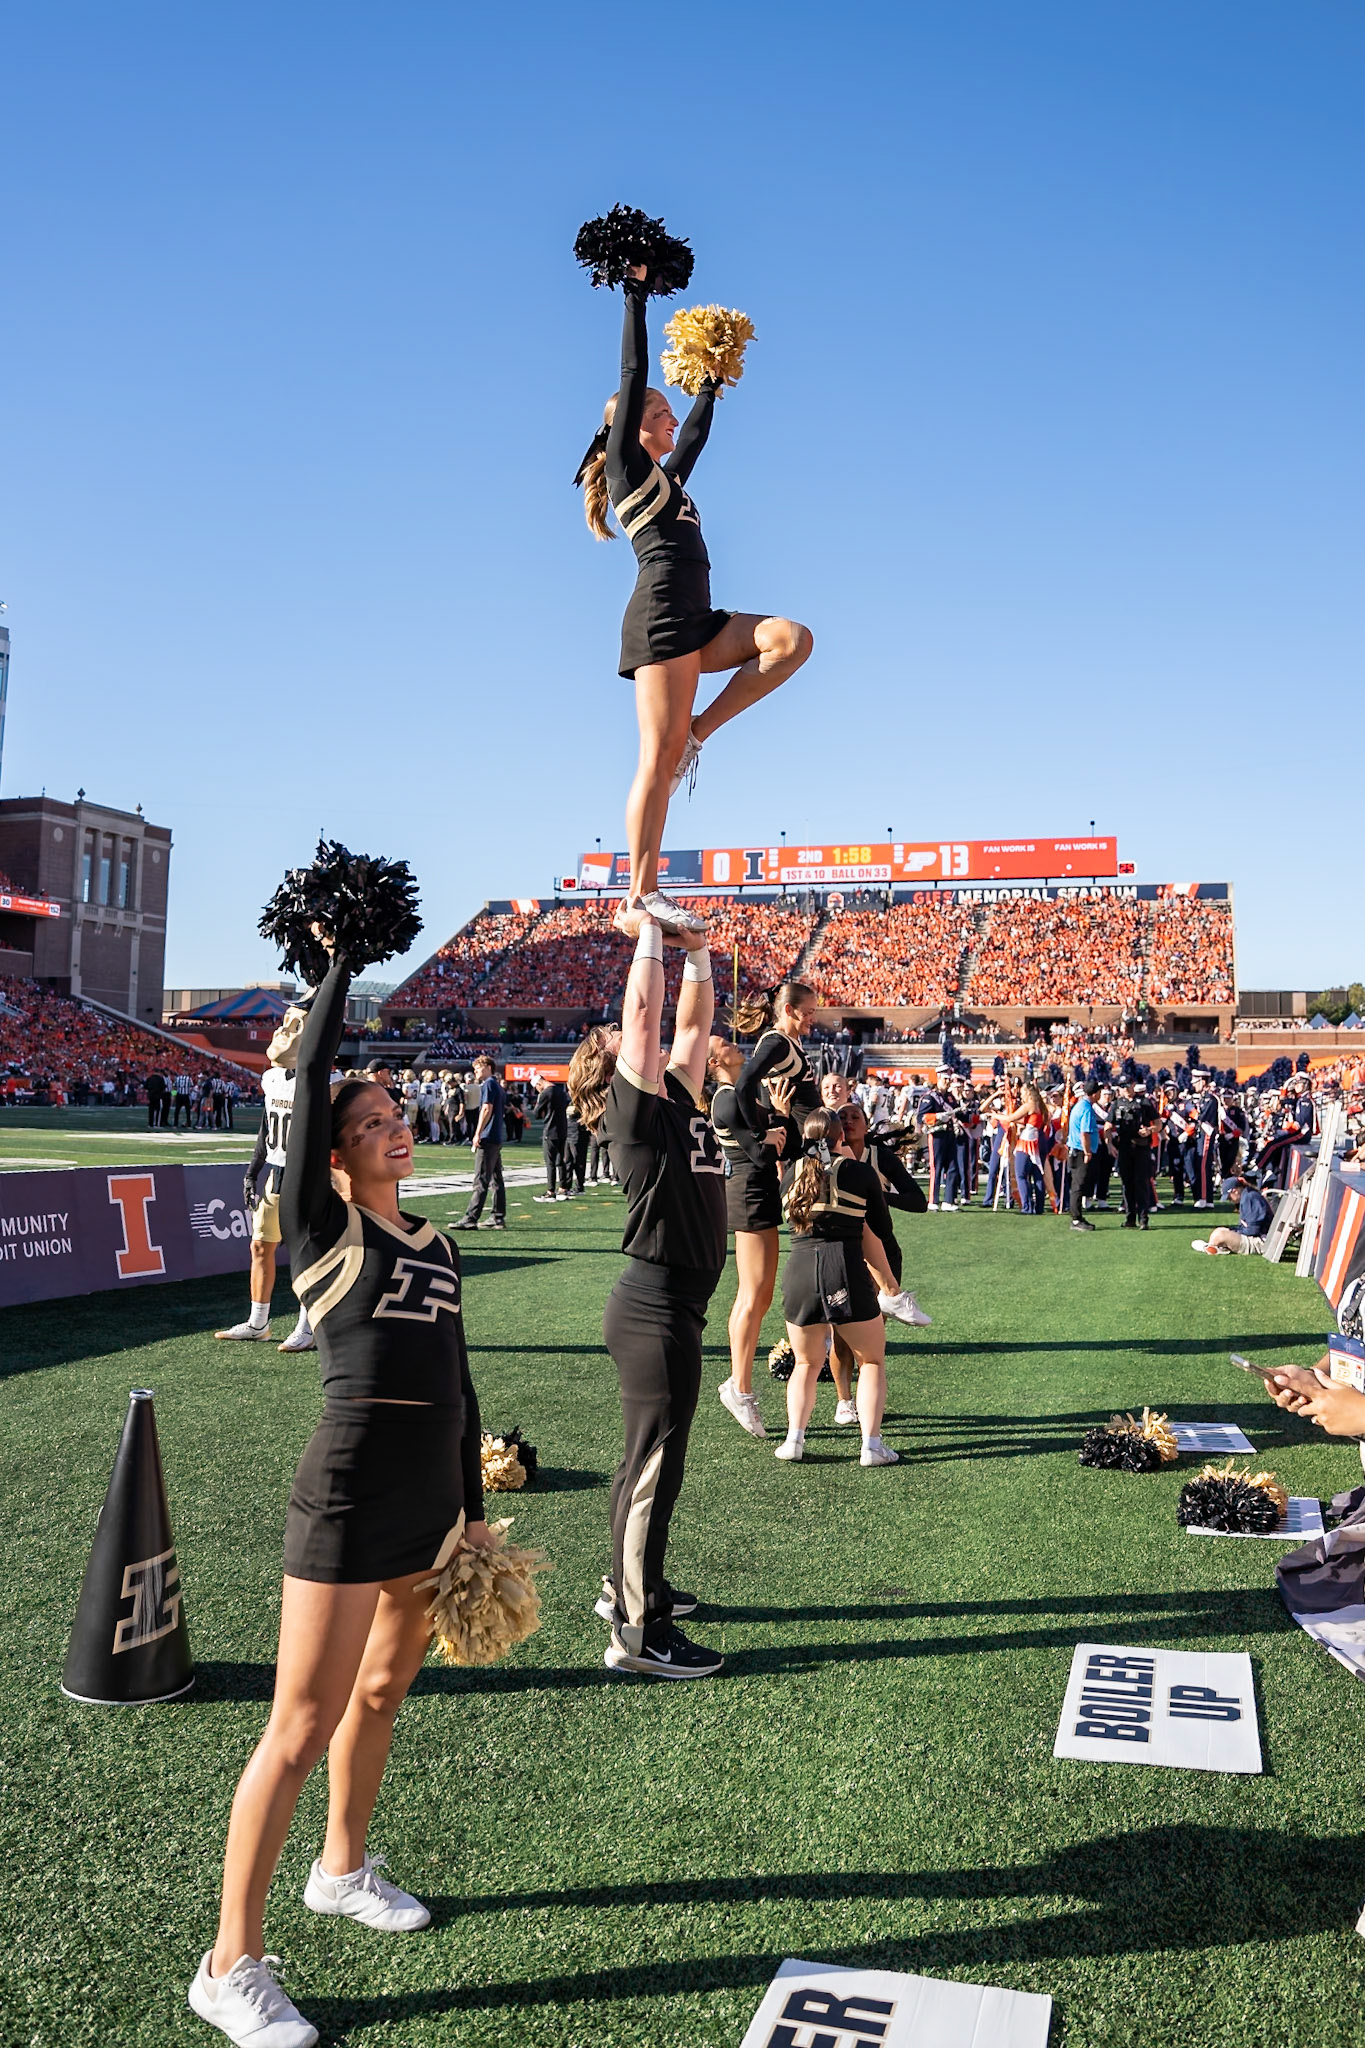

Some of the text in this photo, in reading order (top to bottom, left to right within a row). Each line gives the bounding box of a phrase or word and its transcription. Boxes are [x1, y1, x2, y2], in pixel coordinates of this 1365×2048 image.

[797, 849, 823, 864] 2ND
[832, 846, 872, 864] 1:58
[1054, 843, 1071, 851] FAN
[1073, 842, 1098, 850] WORK
[713, 852, 730, 882] 0
[939, 845, 969, 876] 13
[787, 870, 803, 880] 1ST
[814, 869, 826, 879] 10
[832, 868, 855, 878] BALL
[858, 867, 872, 878] ON
[874, 867, 888, 877] 33
[958, 888, 1054, 904] MEMORIAL
[1056, 886, 1138, 900] STADUM
[23, 1237, 73, 1258] UNION
[372, 1257, 461, 1323] P
[1072, 1653, 1157, 1744] BOILER
[1167, 1684, 1245, 1722] UP
